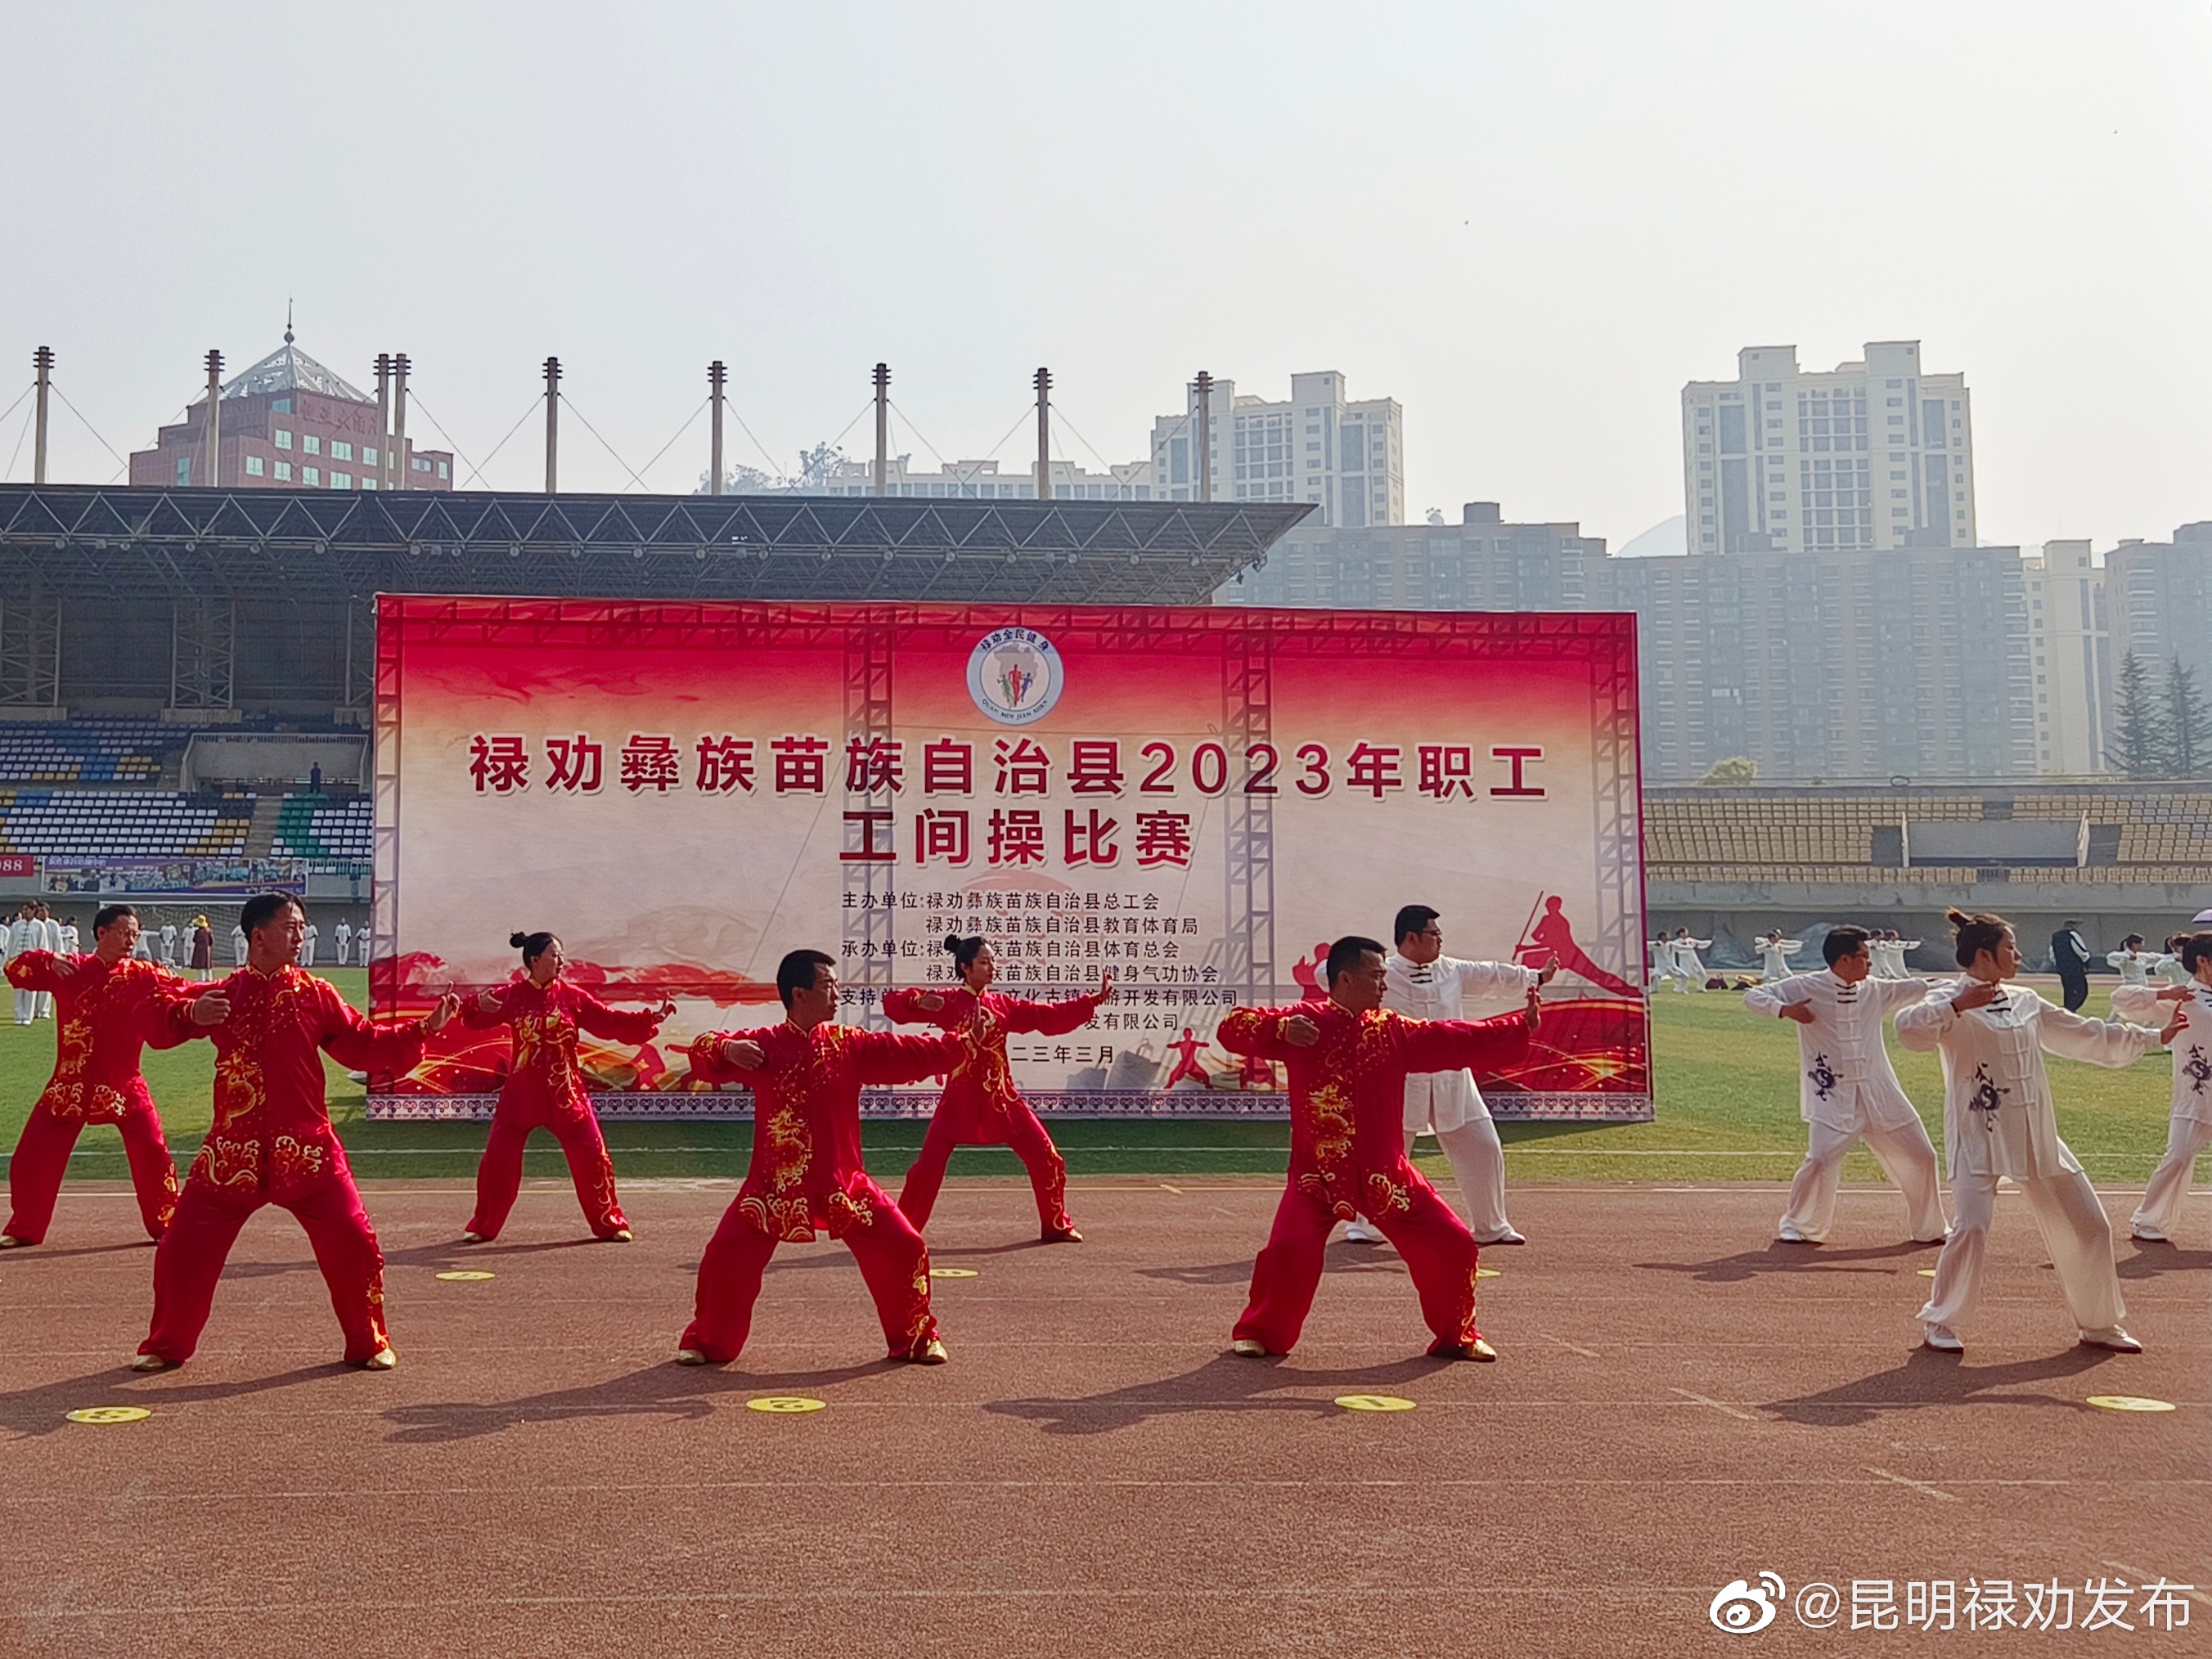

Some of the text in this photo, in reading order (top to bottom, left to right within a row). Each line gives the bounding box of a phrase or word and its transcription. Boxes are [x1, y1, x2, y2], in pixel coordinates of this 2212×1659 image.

[982, 699, 999, 713] QUAN
[1000, 711, 1014, 720] MIN
[1016, 710, 1032, 720] JIAN
[469, 734, 1546, 799] 禄劝彝族苗族自治县2023年职工
[838, 807, 1193, 867] 工间操比赛
[925, 915, 1198, 935] 禄劝彝族苗族自治县教育体育局
